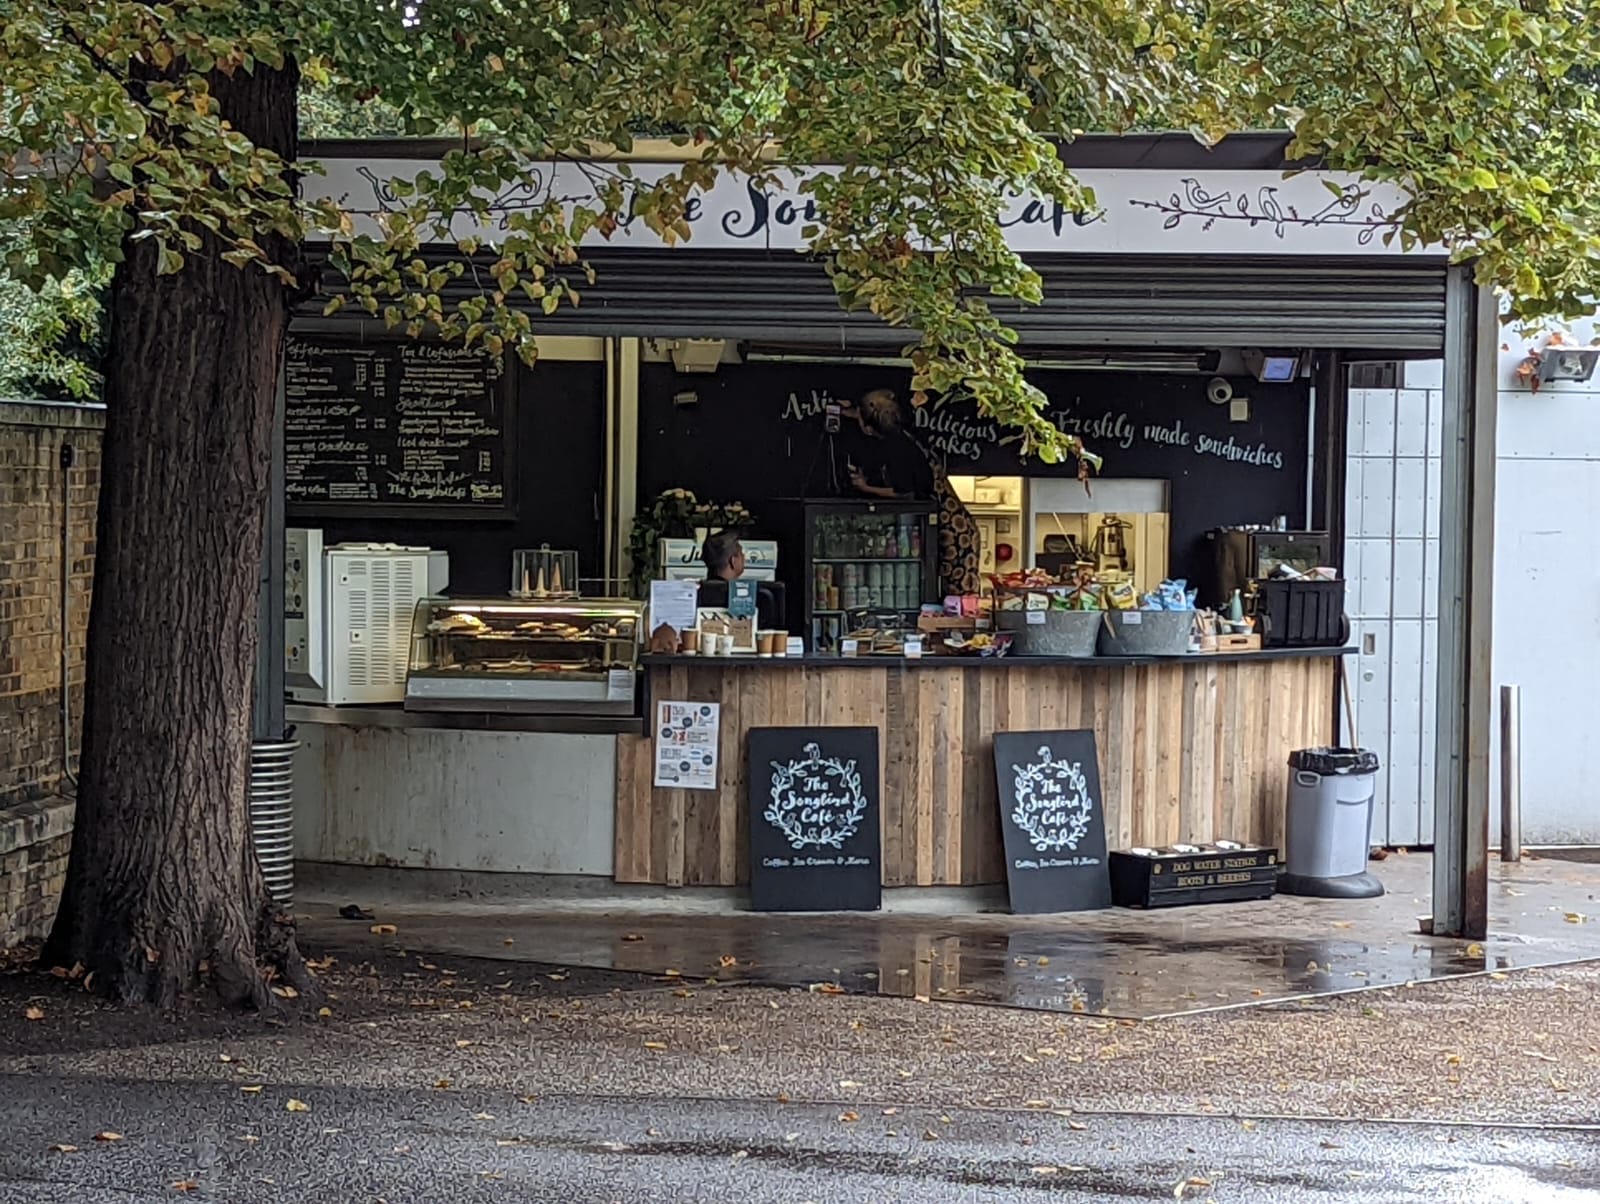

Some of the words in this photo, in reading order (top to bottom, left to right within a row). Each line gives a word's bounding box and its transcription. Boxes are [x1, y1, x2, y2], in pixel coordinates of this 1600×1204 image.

[914, 406, 998, 443] Delicious
[1050, 408, 1135, 449] Freshly
[1144, 419, 1190, 446] made
[803, 776, 829, 792] The
[1040, 779, 1062, 794] The
